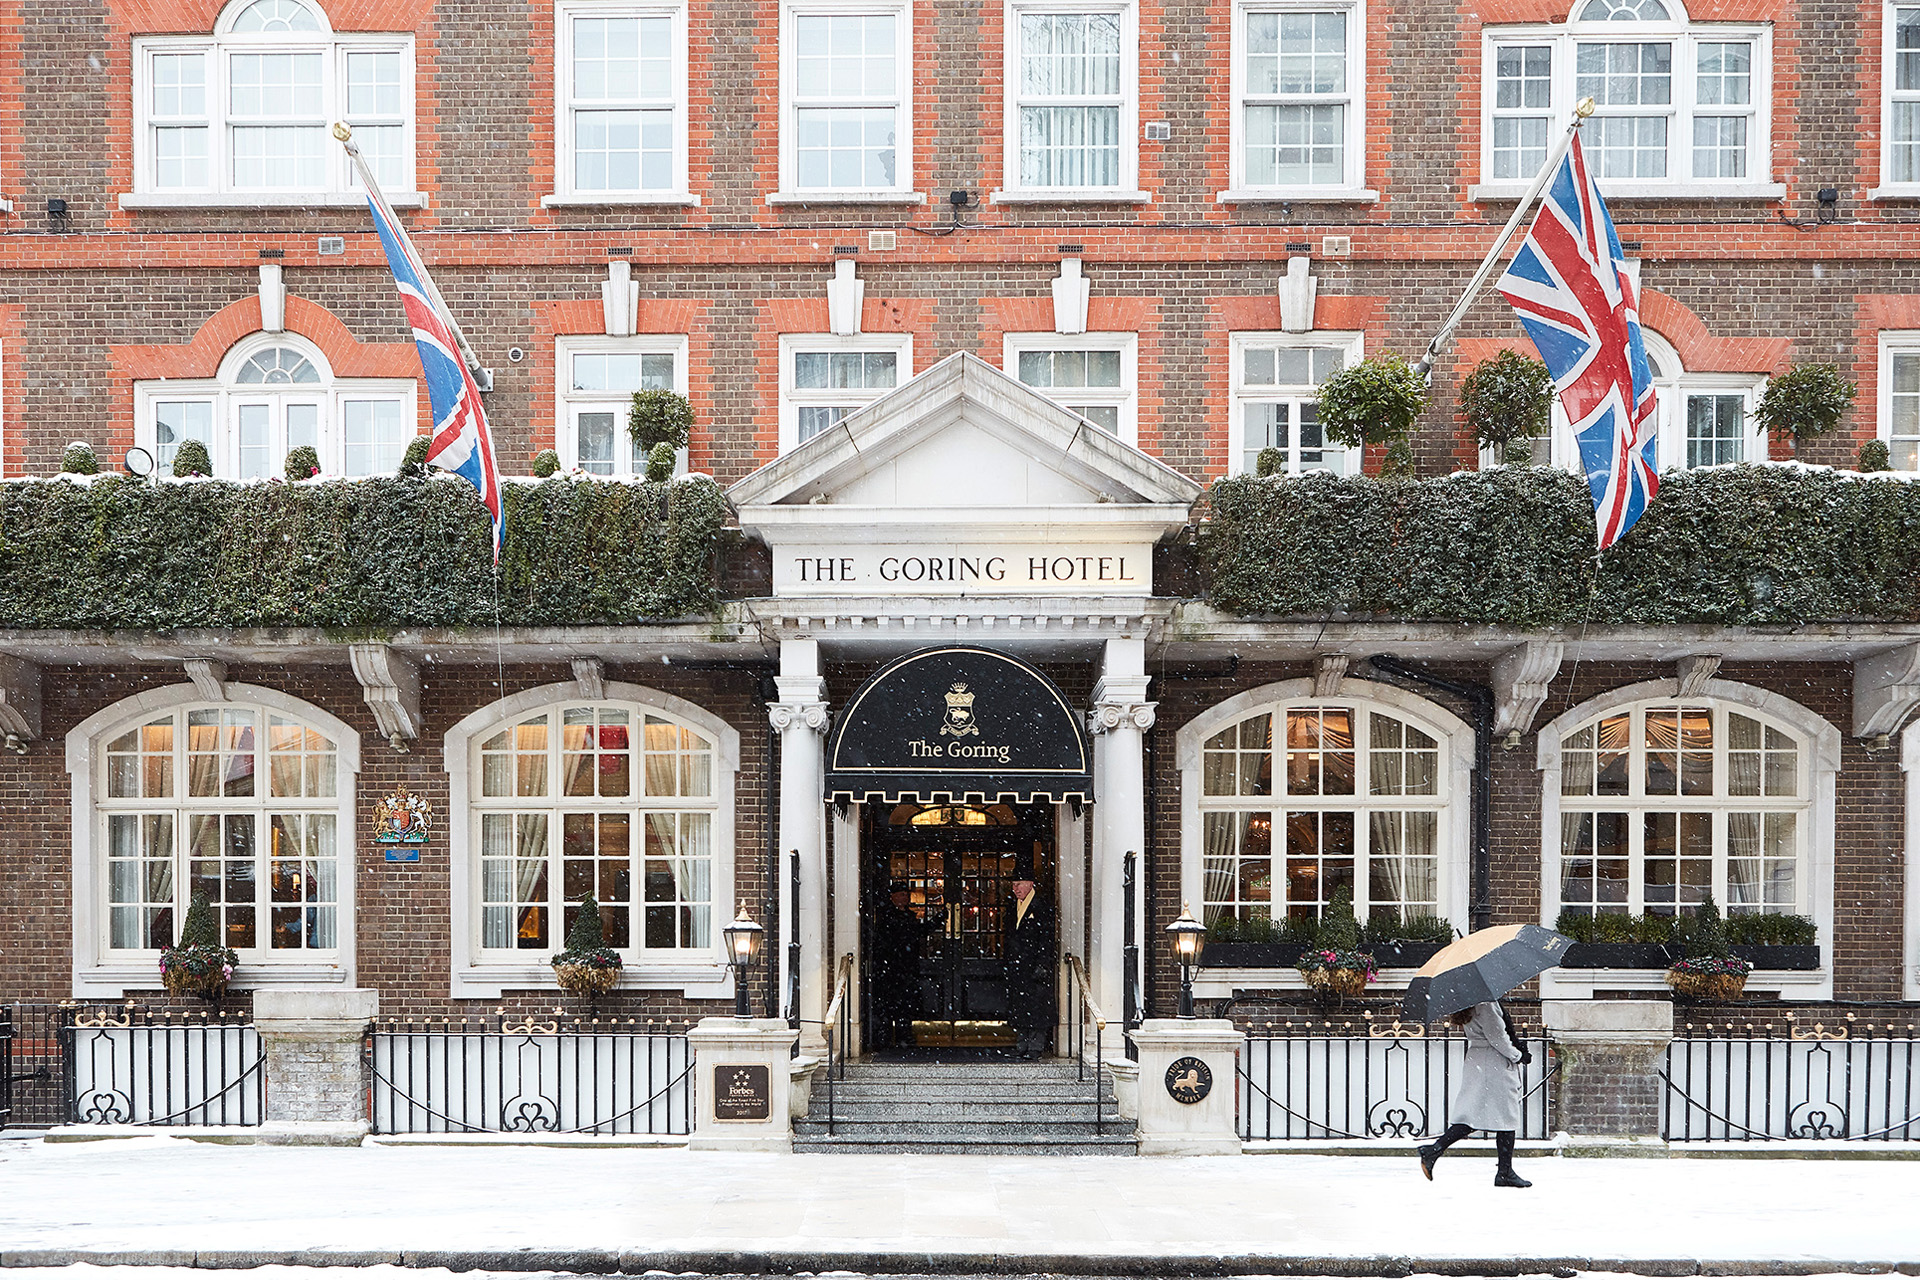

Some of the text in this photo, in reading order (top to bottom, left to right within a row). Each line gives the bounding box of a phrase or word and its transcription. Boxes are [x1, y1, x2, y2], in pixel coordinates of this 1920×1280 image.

[795, 557, 1135, 581] THE GORING HOTEL
[908, 740, 1011, 764] The Goring
